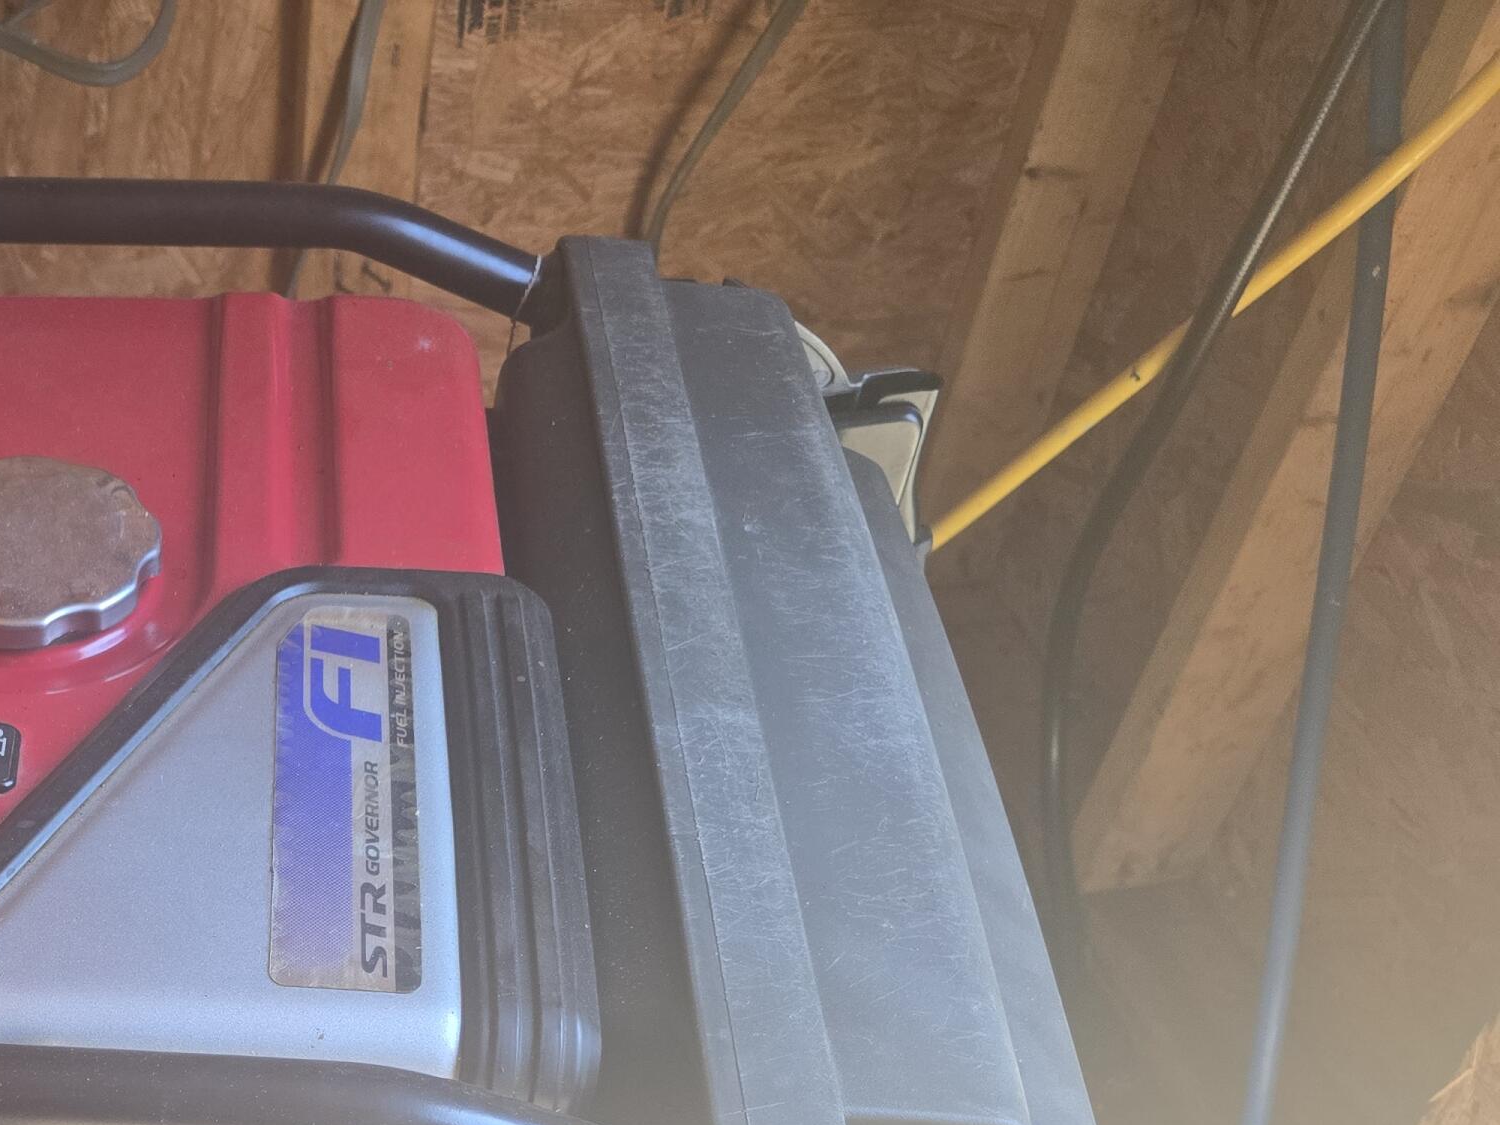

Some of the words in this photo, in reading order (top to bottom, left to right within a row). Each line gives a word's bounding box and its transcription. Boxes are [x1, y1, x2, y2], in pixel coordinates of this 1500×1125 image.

[310, 625, 383, 742] FI
[393, 630, 408, 702] INJECTION
[396, 707, 408, 748] FUEL
[366, 760, 381, 876] GOVERNOR
[361, 883, 388, 978] STR
